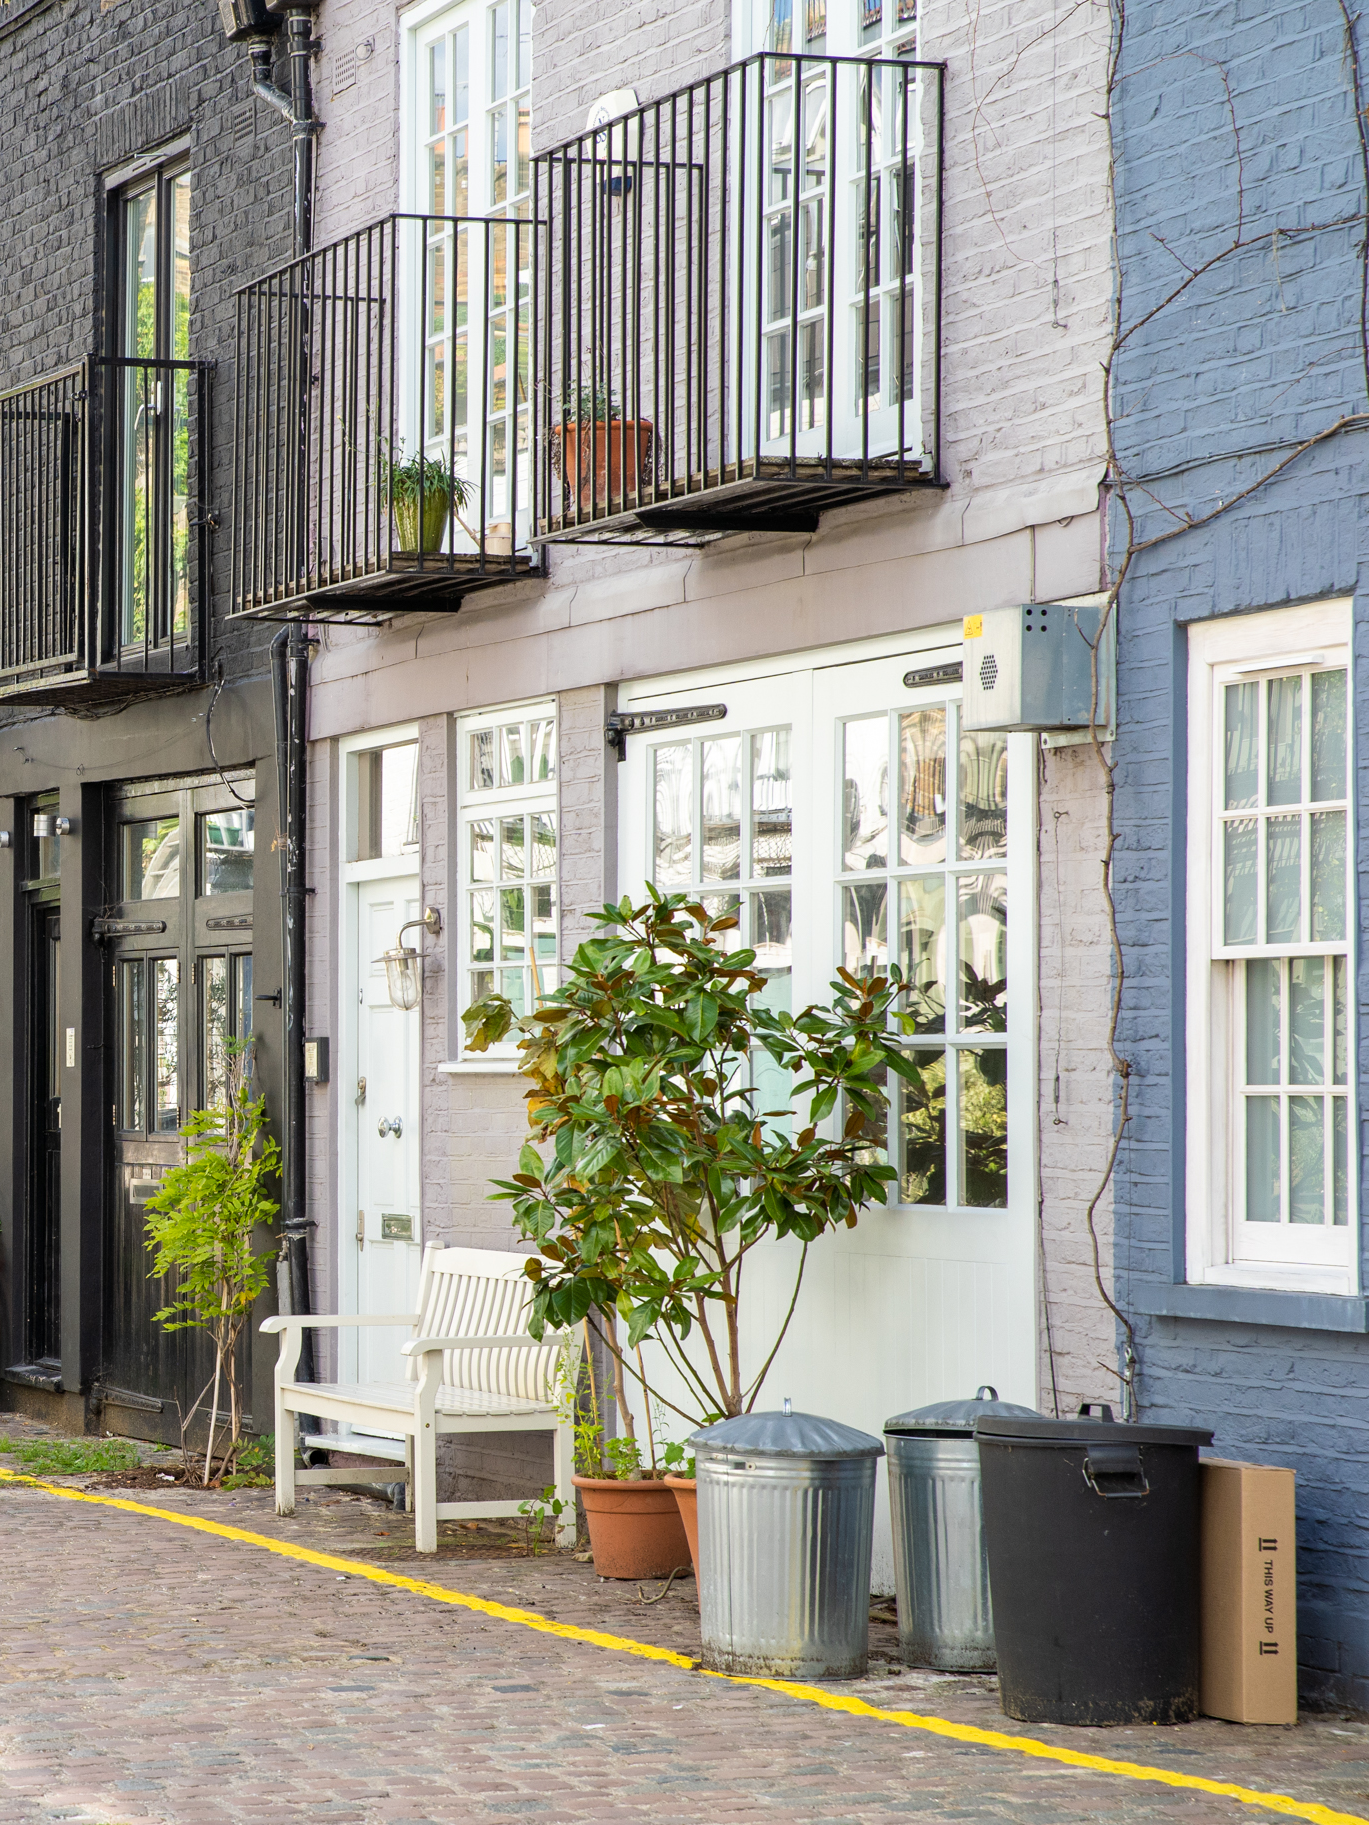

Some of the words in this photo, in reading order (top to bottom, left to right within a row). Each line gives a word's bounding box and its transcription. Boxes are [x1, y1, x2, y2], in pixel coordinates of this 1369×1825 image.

[1264, 1559, 1273, 1586] THIS
[1264, 1589, 1273, 1614] WAY
[1264, 1617, 1273, 1633] UP
